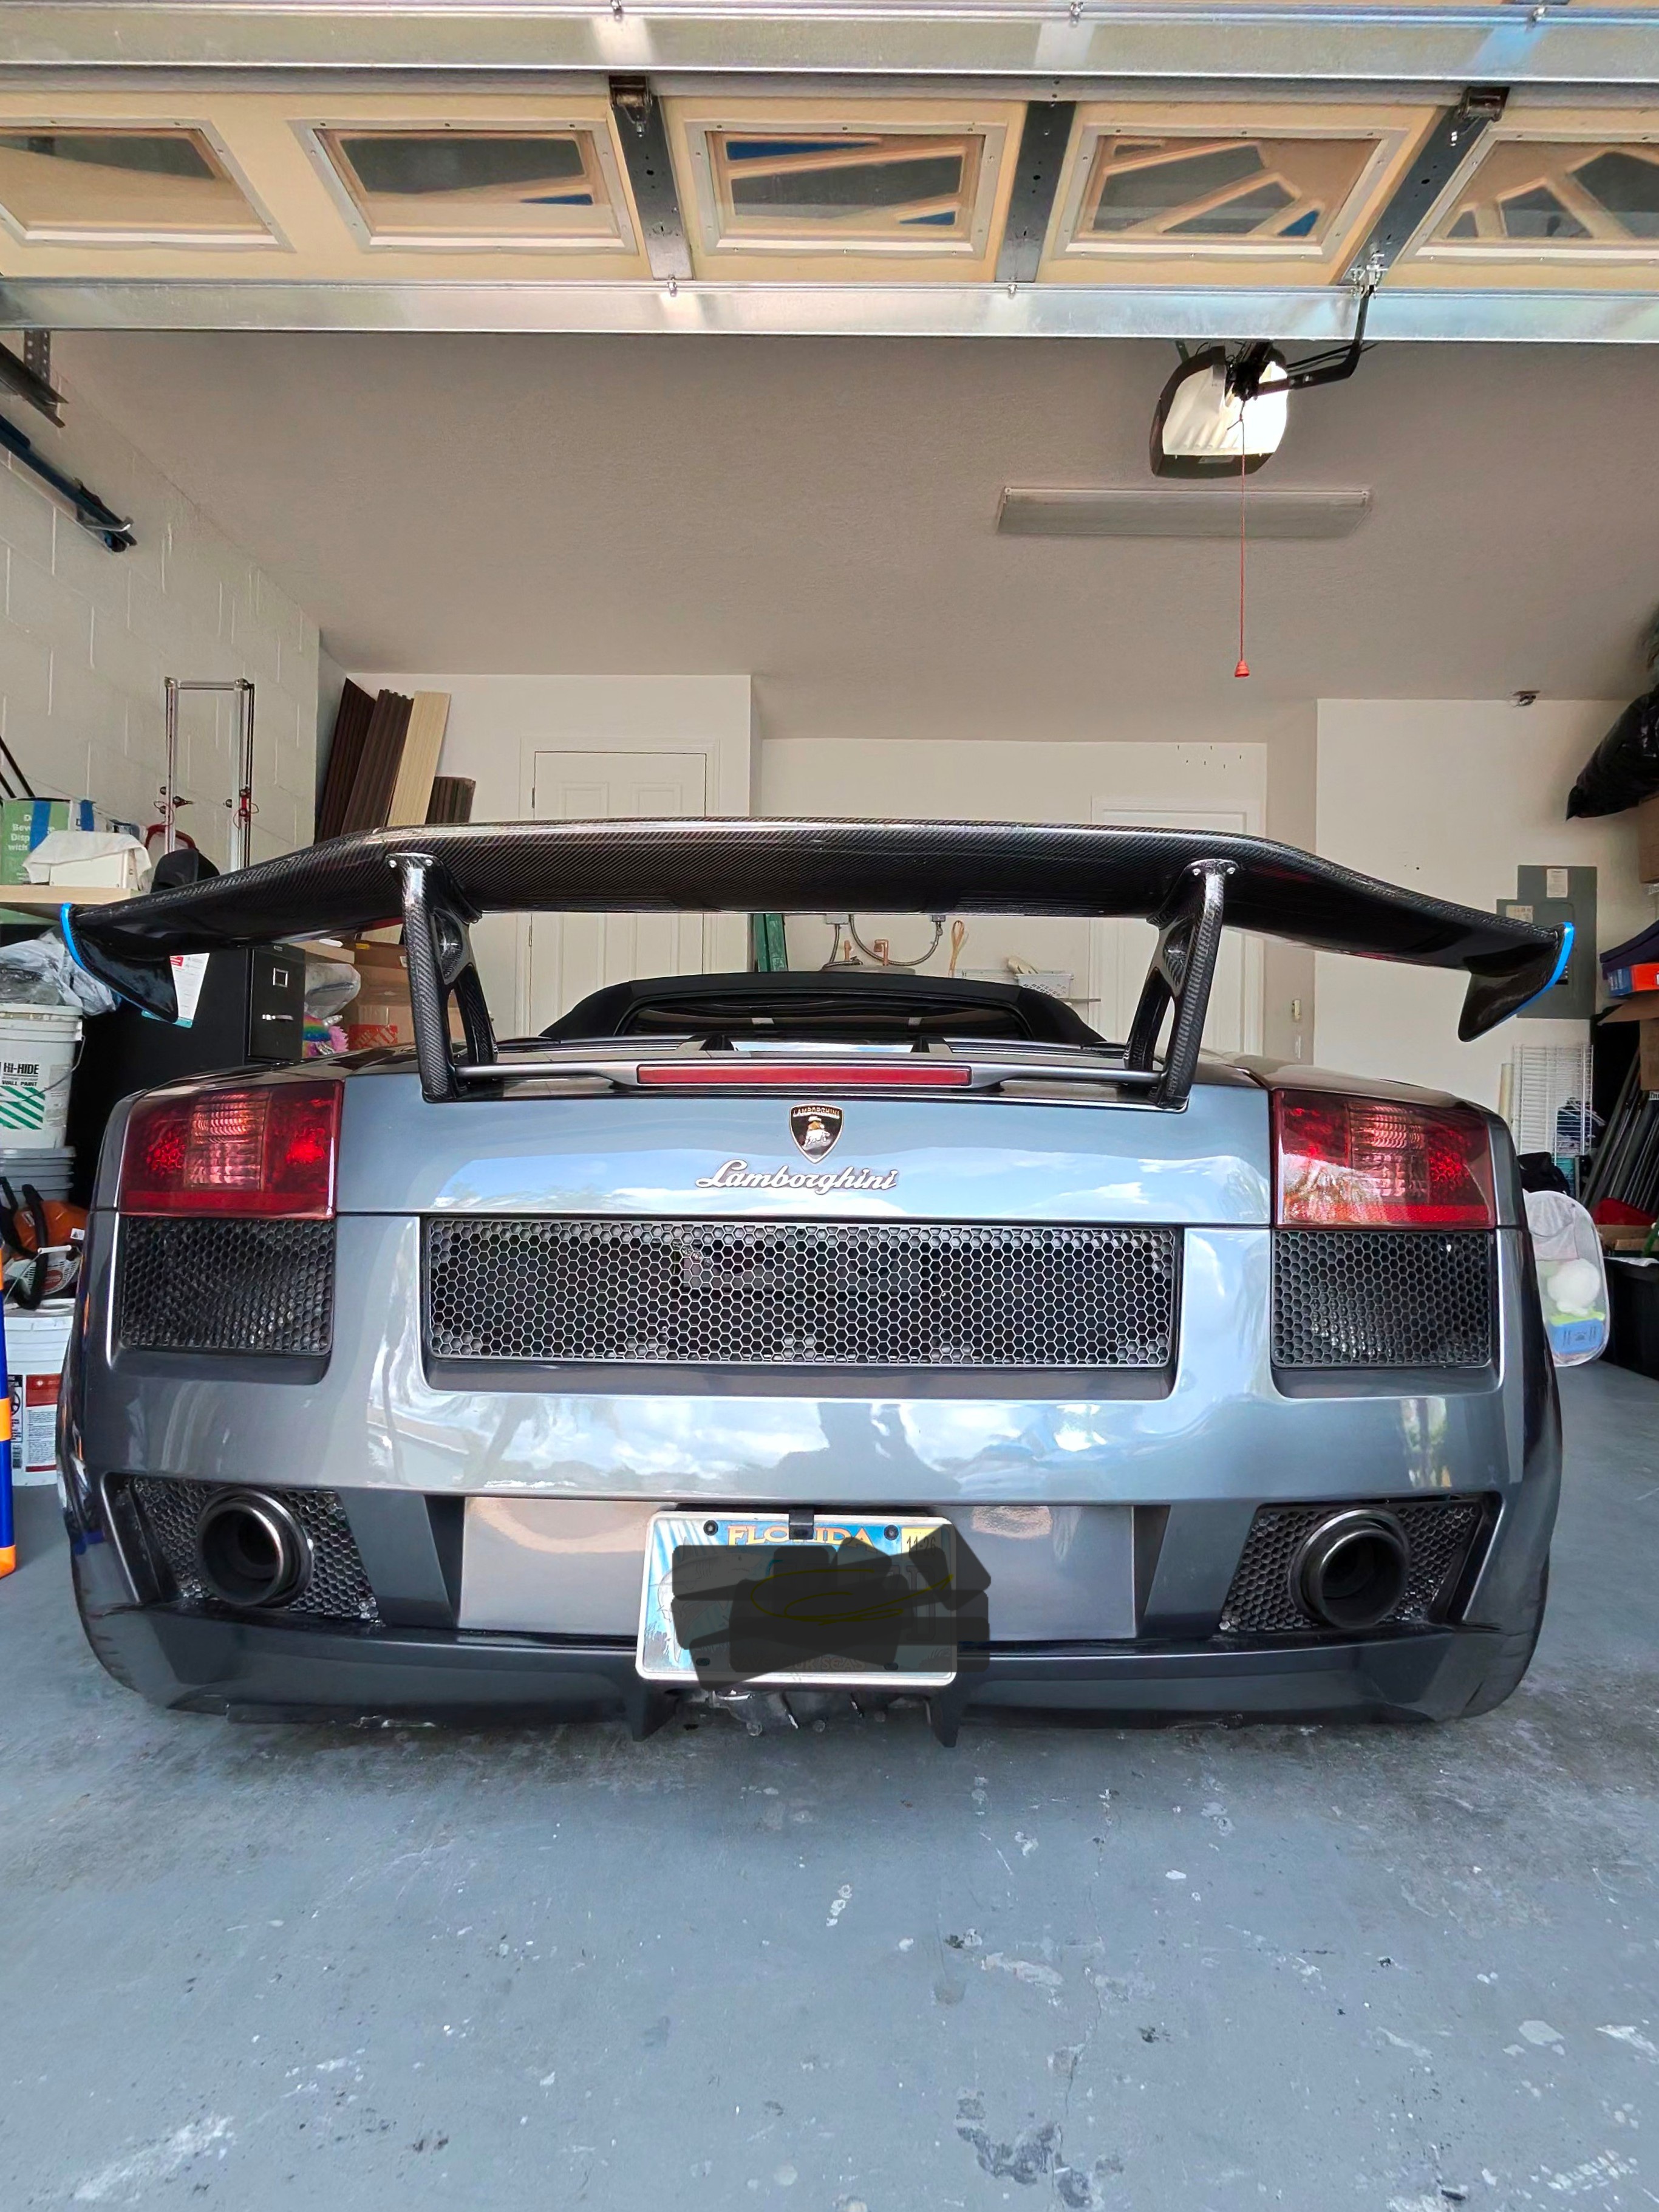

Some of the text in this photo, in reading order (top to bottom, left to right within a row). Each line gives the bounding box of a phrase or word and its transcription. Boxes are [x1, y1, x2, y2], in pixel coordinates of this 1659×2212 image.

[4, 1062, 39, 1074] HI-HIDE
[793, 1107, 840, 1118] LAMBORGHINI
[695, 1159, 899, 1195] Lamborghini
[726, 1524, 877, 1554] FLOIDA
[907, 1536, 936, 1558] 11-26
